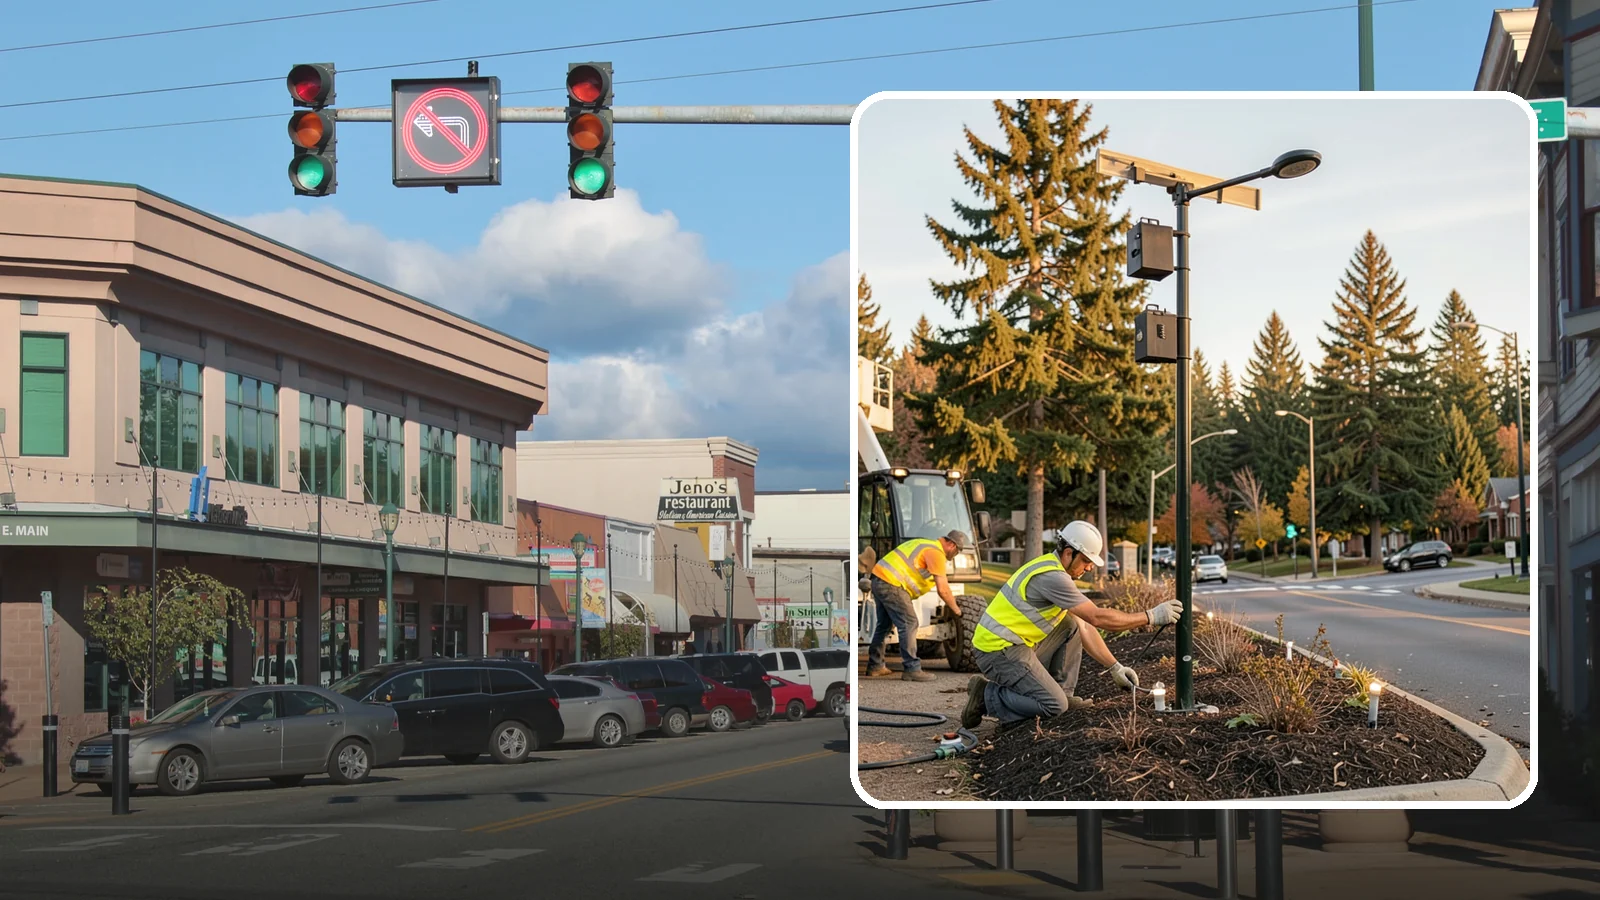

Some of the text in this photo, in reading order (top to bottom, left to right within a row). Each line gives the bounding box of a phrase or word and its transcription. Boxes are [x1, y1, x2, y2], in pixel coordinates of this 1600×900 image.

[670, 480, 727, 494] Jeno's
[665, 497, 731, 508] restaurant
[658, 509, 682, 520] Italian
[686, 509, 715, 519] American
[715, 509, 737, 519] Cuisine
[2, 525, 49, 536] E. MAIN
[797, 607, 828, 617] Street
